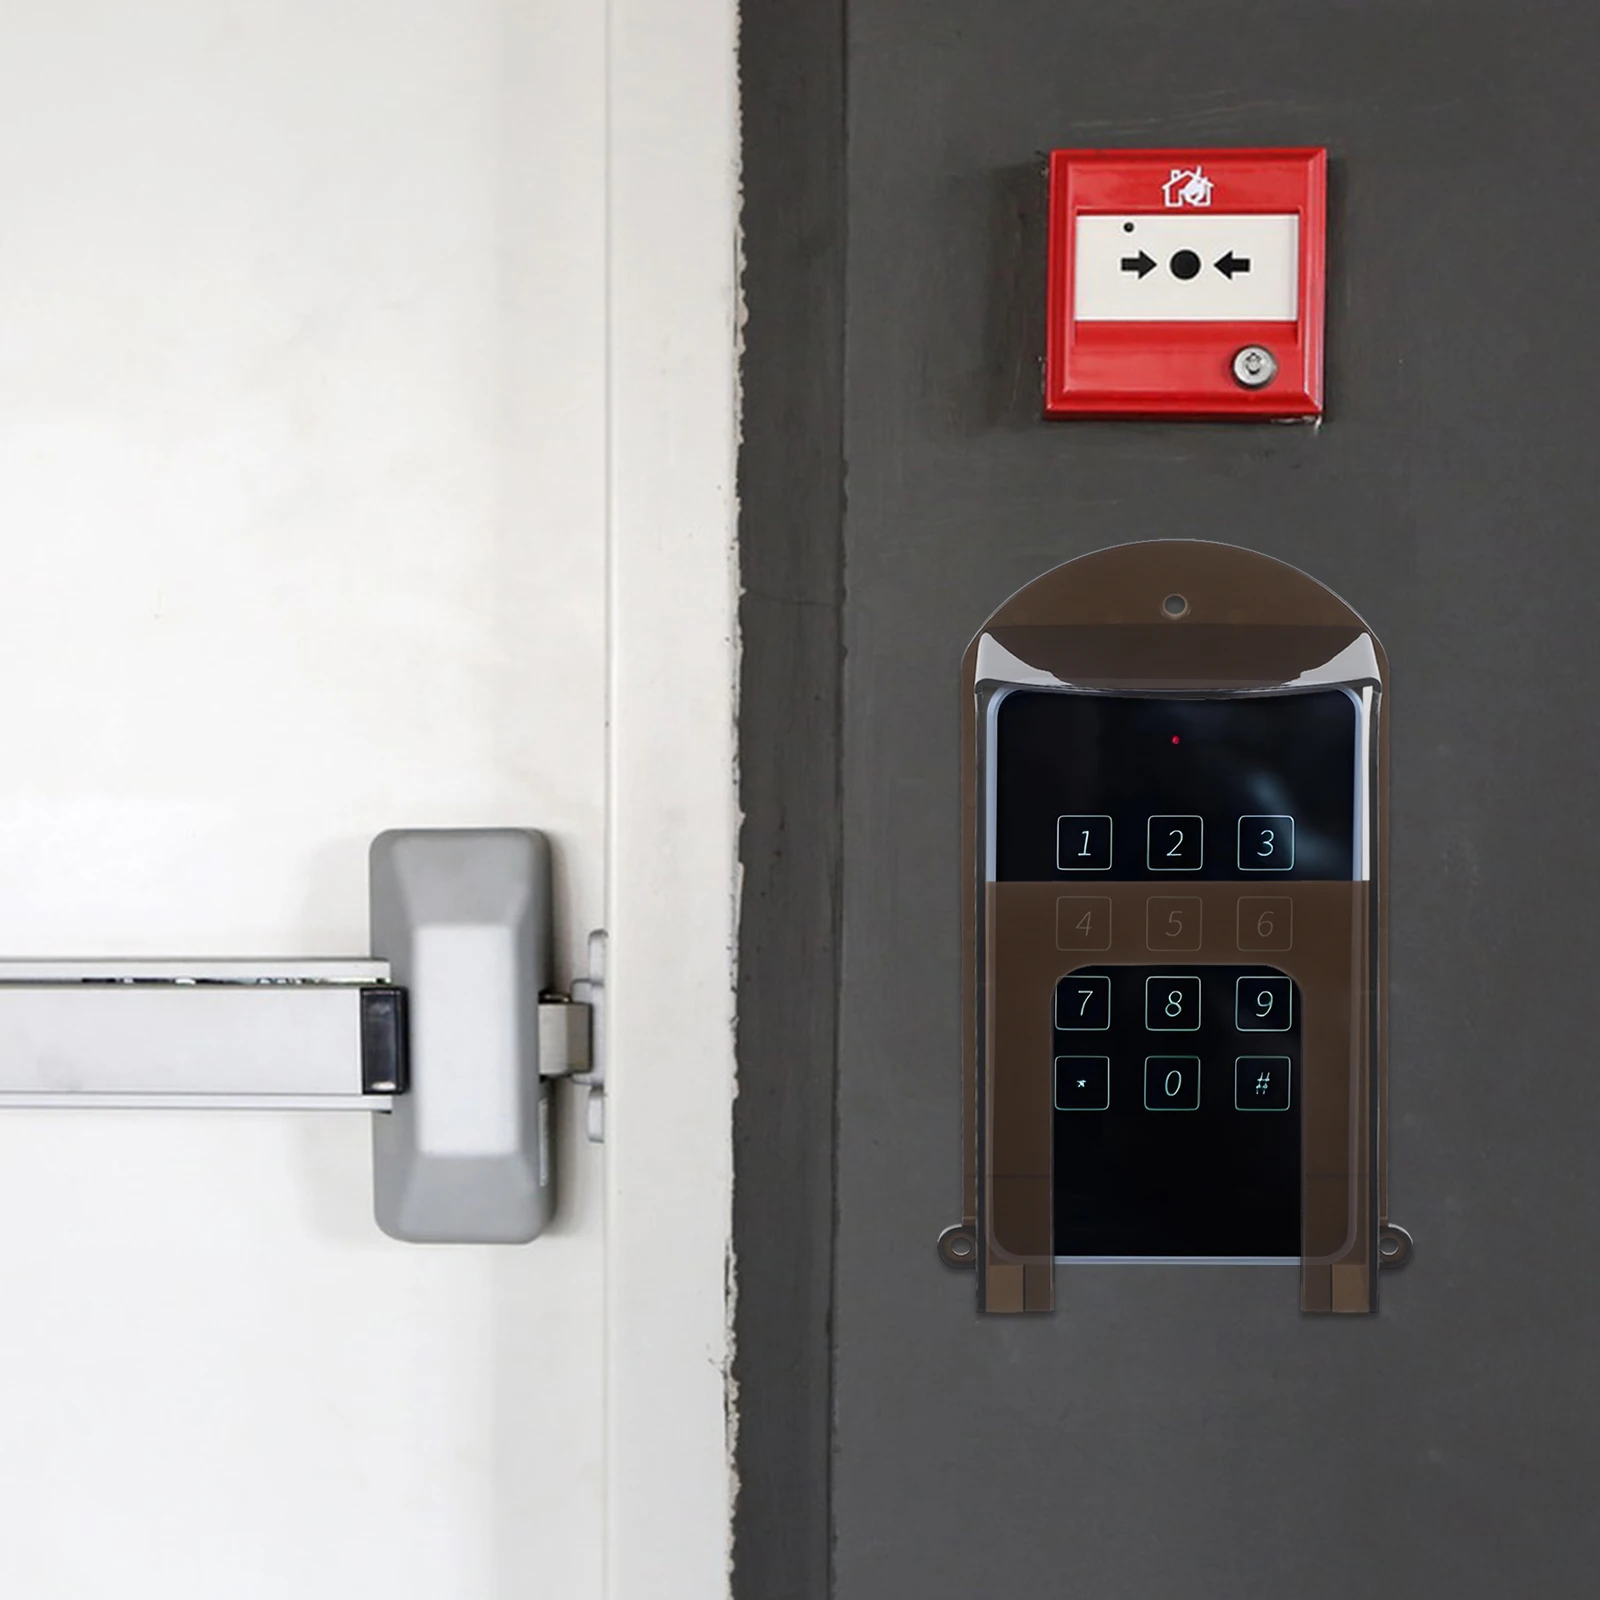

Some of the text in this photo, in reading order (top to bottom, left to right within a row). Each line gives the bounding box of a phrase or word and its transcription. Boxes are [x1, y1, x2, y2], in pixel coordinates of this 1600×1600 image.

[1077, 830, 1092, 857] 1
[1166, 829, 1184, 857] 2
[1256, 829, 1275, 857] 3
[1075, 911, 1093, 937] 4
[1165, 910, 1183, 937] 5
[1257, 911, 1275, 938] 6
[1077, 990, 1094, 1017] 7
[1164, 990, 1183, 1018] 8
[1255, 990, 1274, 1018] 9
[1164, 1070, 1182, 1097] 0
